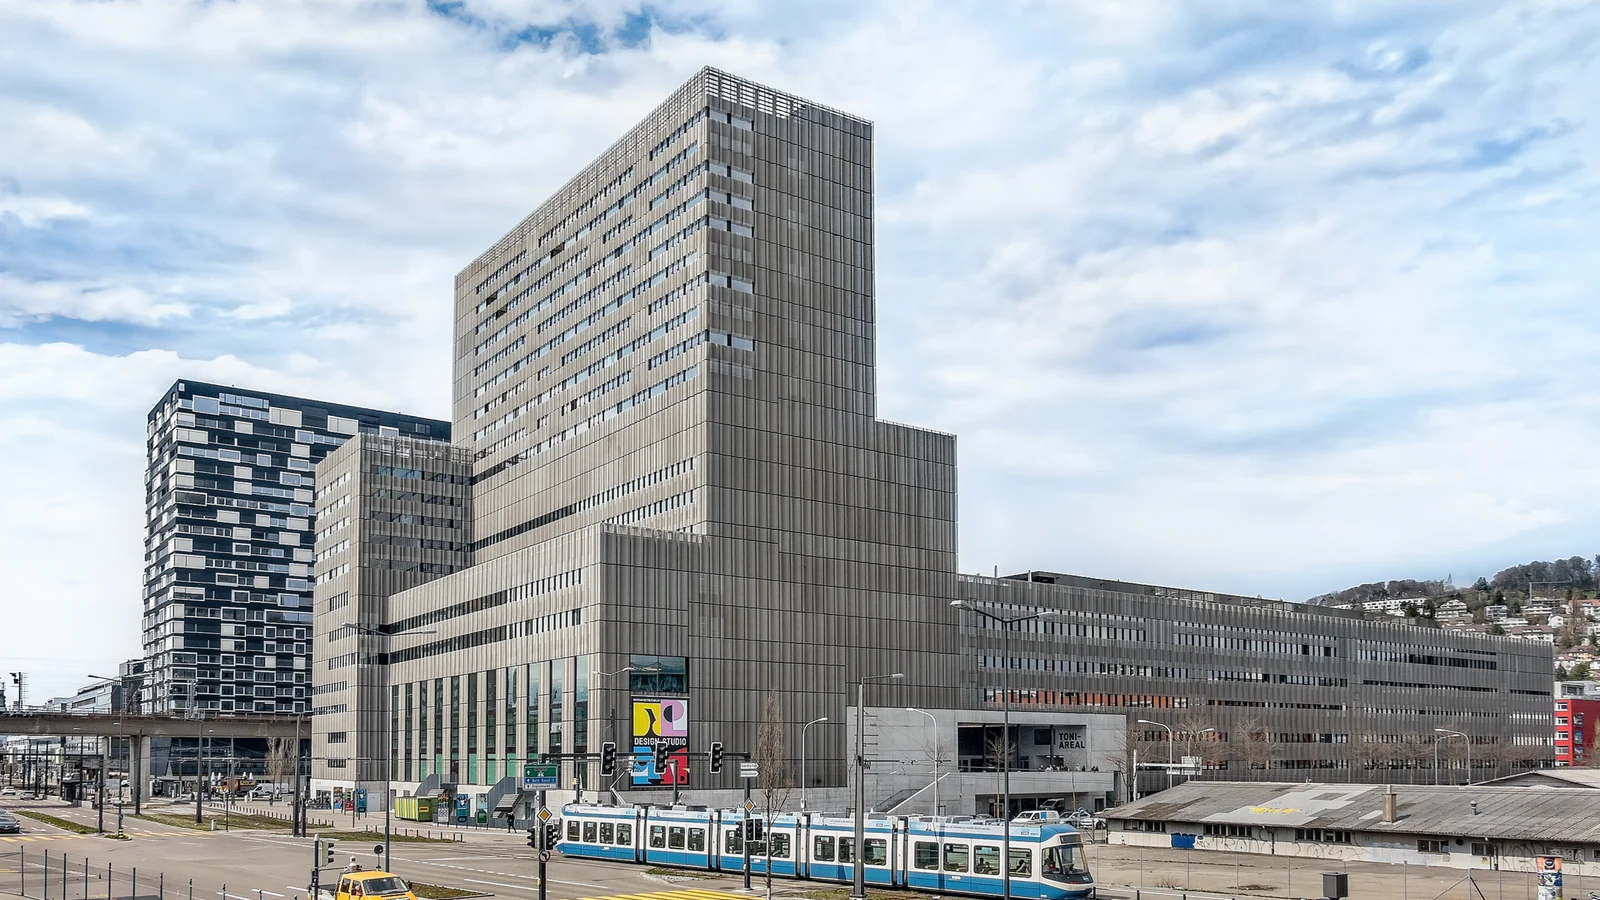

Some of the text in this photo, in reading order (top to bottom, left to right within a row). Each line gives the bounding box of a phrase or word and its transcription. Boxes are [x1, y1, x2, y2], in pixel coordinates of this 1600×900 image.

[1059, 732, 1081, 740] TONI-
[634, 737, 659, 745] DESIGN
[1059, 741, 1085, 749] AREAL
